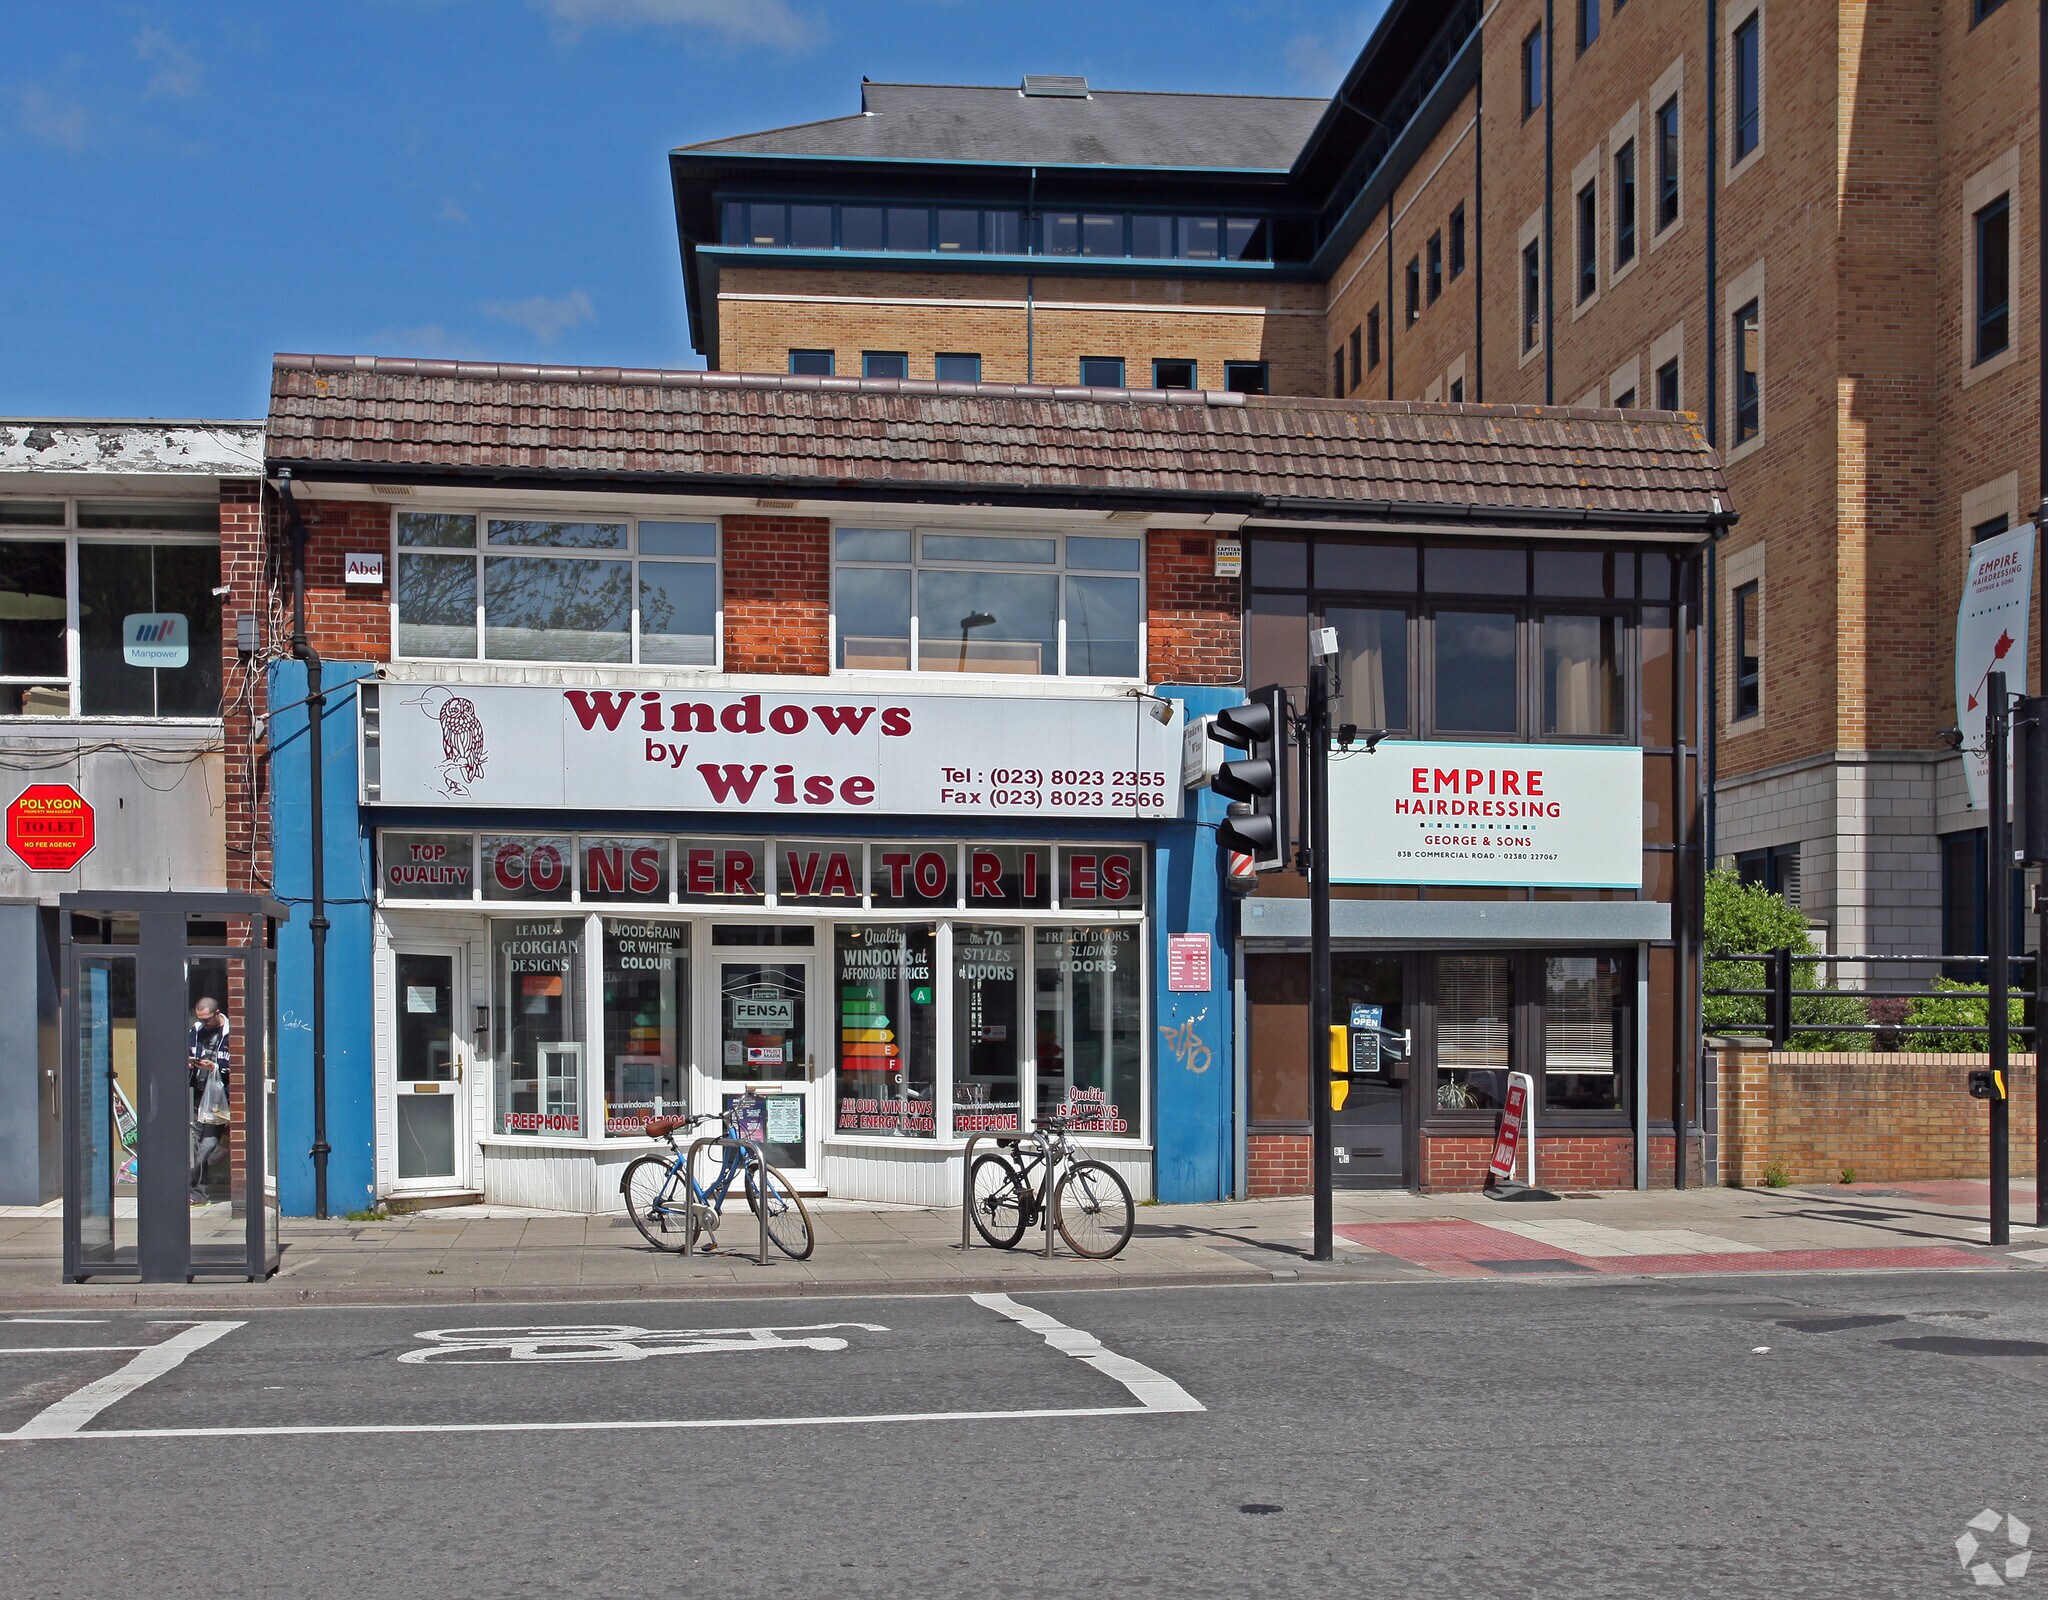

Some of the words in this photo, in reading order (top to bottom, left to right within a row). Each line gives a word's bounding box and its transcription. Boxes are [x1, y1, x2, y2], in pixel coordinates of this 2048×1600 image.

[348, 560, 382, 576] Abel
[1979, 552, 2018, 575] EMPIRE
[1972, 564, 2022, 587] HAIRDRESSING
[1976, 583, 1995, 594] GEORGE
[2001, 578, 2014, 586] SONS
[131, 649, 178, 660] Manpower
[563, 690, 912, 737] Windows
[645, 738, 689, 768] by
[696, 763, 876, 806] Wise
[941, 768, 971, 783] Tel
[990, 768, 1044, 787] (023)
[1051, 770, 1104, 786] 8023
[1112, 772, 1166, 786] 2355
[1412, 768, 1544, 796] EMPIRE
[20, 800, 82, 809] POLYGON
[941, 788, 982, 804] Fax
[989, 789, 1043, 808] (023)
[1050, 790, 1104, 806] 8023
[1111, 792, 1165, 808] 2566
[1395, 798, 1561, 818] HAIRDRESSING
[24, 822, 44, 832] TO
[48, 822, 76, 832] LET
[1424, 836, 1477, 846] GEORGE
[1483, 837, 1491, 846] &
[1497, 837, 1532, 847] SONS
[410, 844, 446, 862] TOP
[1472, 852, 1495, 860] ROAD
[390, 866, 470, 885] QUALITY
[516, 924, 562, 936] LEADED
[612, 924, 680, 940] WOODGRAIN
[865, 928, 906, 946] Quality
[1091, 930, 1130, 942] DOORS
[984, 931, 1002, 946] 70
[502, 940, 578, 955] GEORGIAN
[619, 940, 636, 953] OR
[639, 941, 673, 954] WHITE
[1068, 945, 1118, 957] SLIDING
[844, 949, 914, 966] WINDOWS
[915, 950, 928, 964] at
[963, 948, 1011, 962] STYLES
[511, 958, 570, 972] DESIGNS
[621, 957, 672, 970] COLOUR
[1060, 960, 1117, 973] DOORS
[842, 967, 896, 980] AFFORDABLE
[900, 967, 929, 980] PRICES
[968, 964, 1015, 981] DOORS
[866, 989, 874, 998] A
[917, 991, 925, 1000] A
[738, 1005, 788, 1016] FENSA
[870, 1003, 876, 1012] B
[876, 1017, 882, 1026] C
[1353, 1018, 1378, 1027] OPEN
[880, 1032, 887, 1040] D
[884, 1046, 891, 1055] E
[889, 1060, 895, 1069] F
[895, 1074, 903, 1084] G
[1070, 1086, 1106, 1104] Quality
[608, 1099, 687, 1110] www.windowsbyise.co.uk
[857, 1100, 878, 1113] OUR
[880, 1100, 933, 1116] WINDOWS
[1057, 1104, 1067, 1116] IS
[505, 1112, 579, 1131] FREEPHONE
[607, 1117, 639, 1132] 0800
[839, 1114, 858, 1128] ARE
[860, 1115, 898, 1129] ENERGY
[902, 1116, 934, 1131] RATED
[956, 1114, 1017, 1131] FREEPHONE
